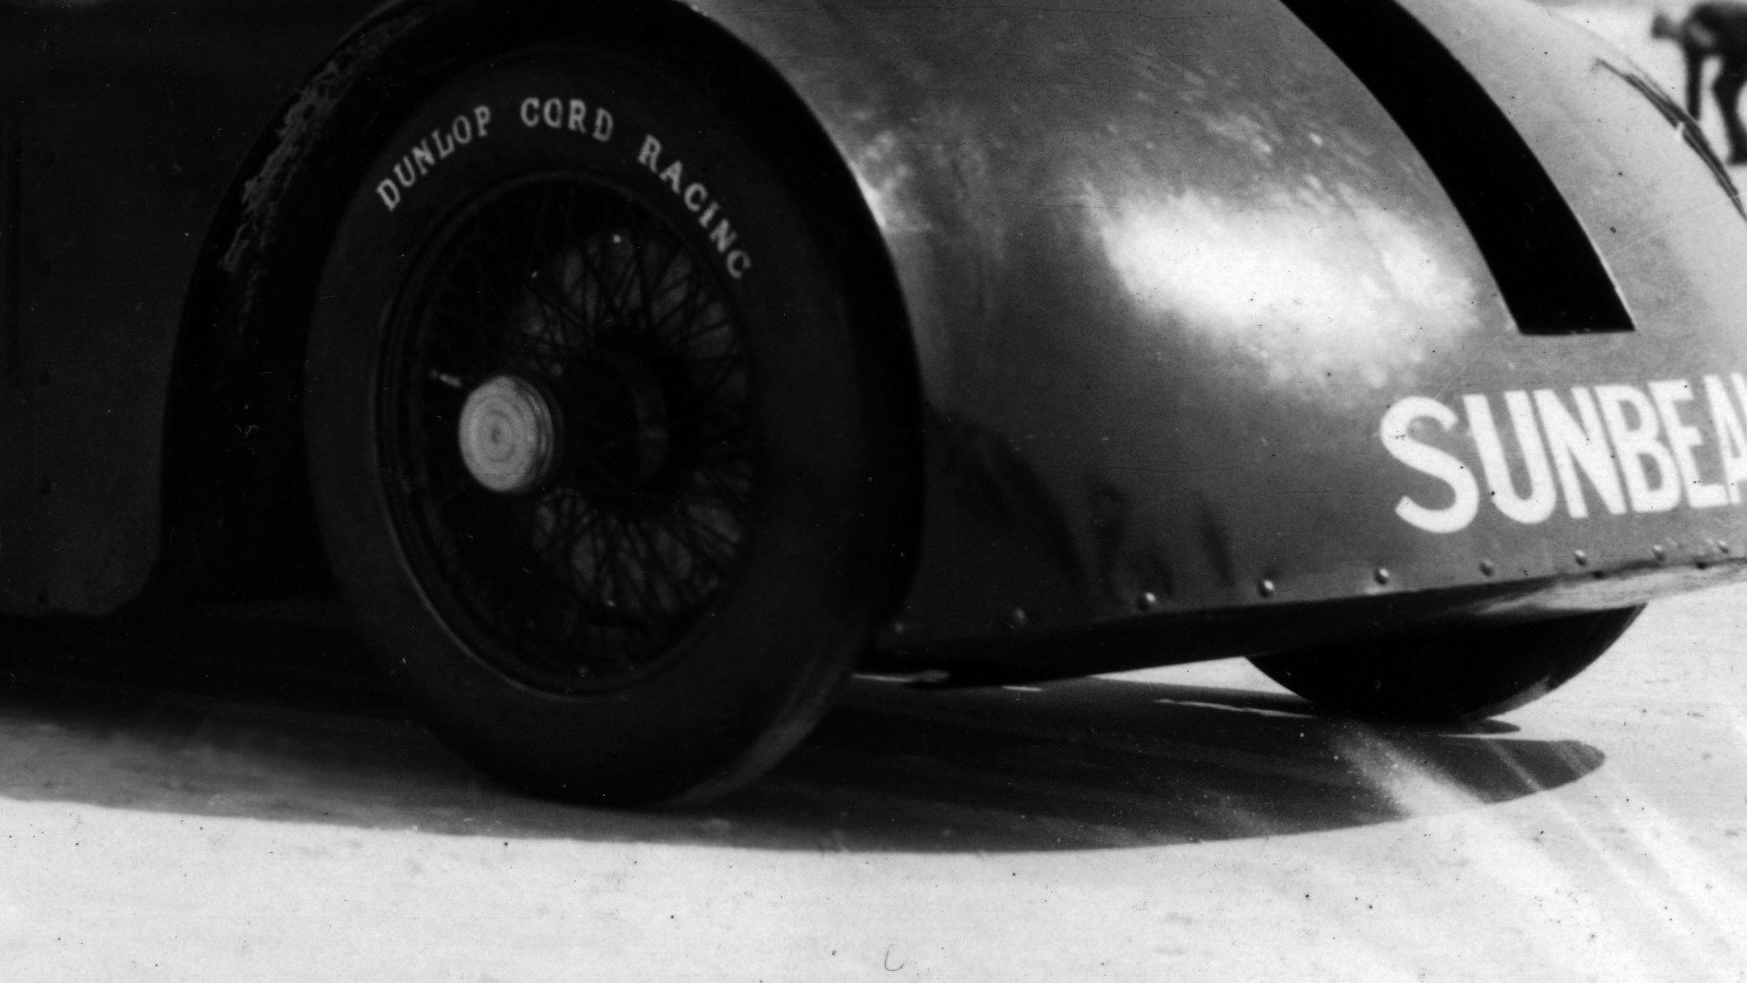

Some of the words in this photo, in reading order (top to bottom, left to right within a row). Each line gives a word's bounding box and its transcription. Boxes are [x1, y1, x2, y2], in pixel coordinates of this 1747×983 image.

[375, 105, 492, 212] DUNLOP
[520, 97, 614, 142] CORD
[1379, 372, 1747, 534] SUNBEA
